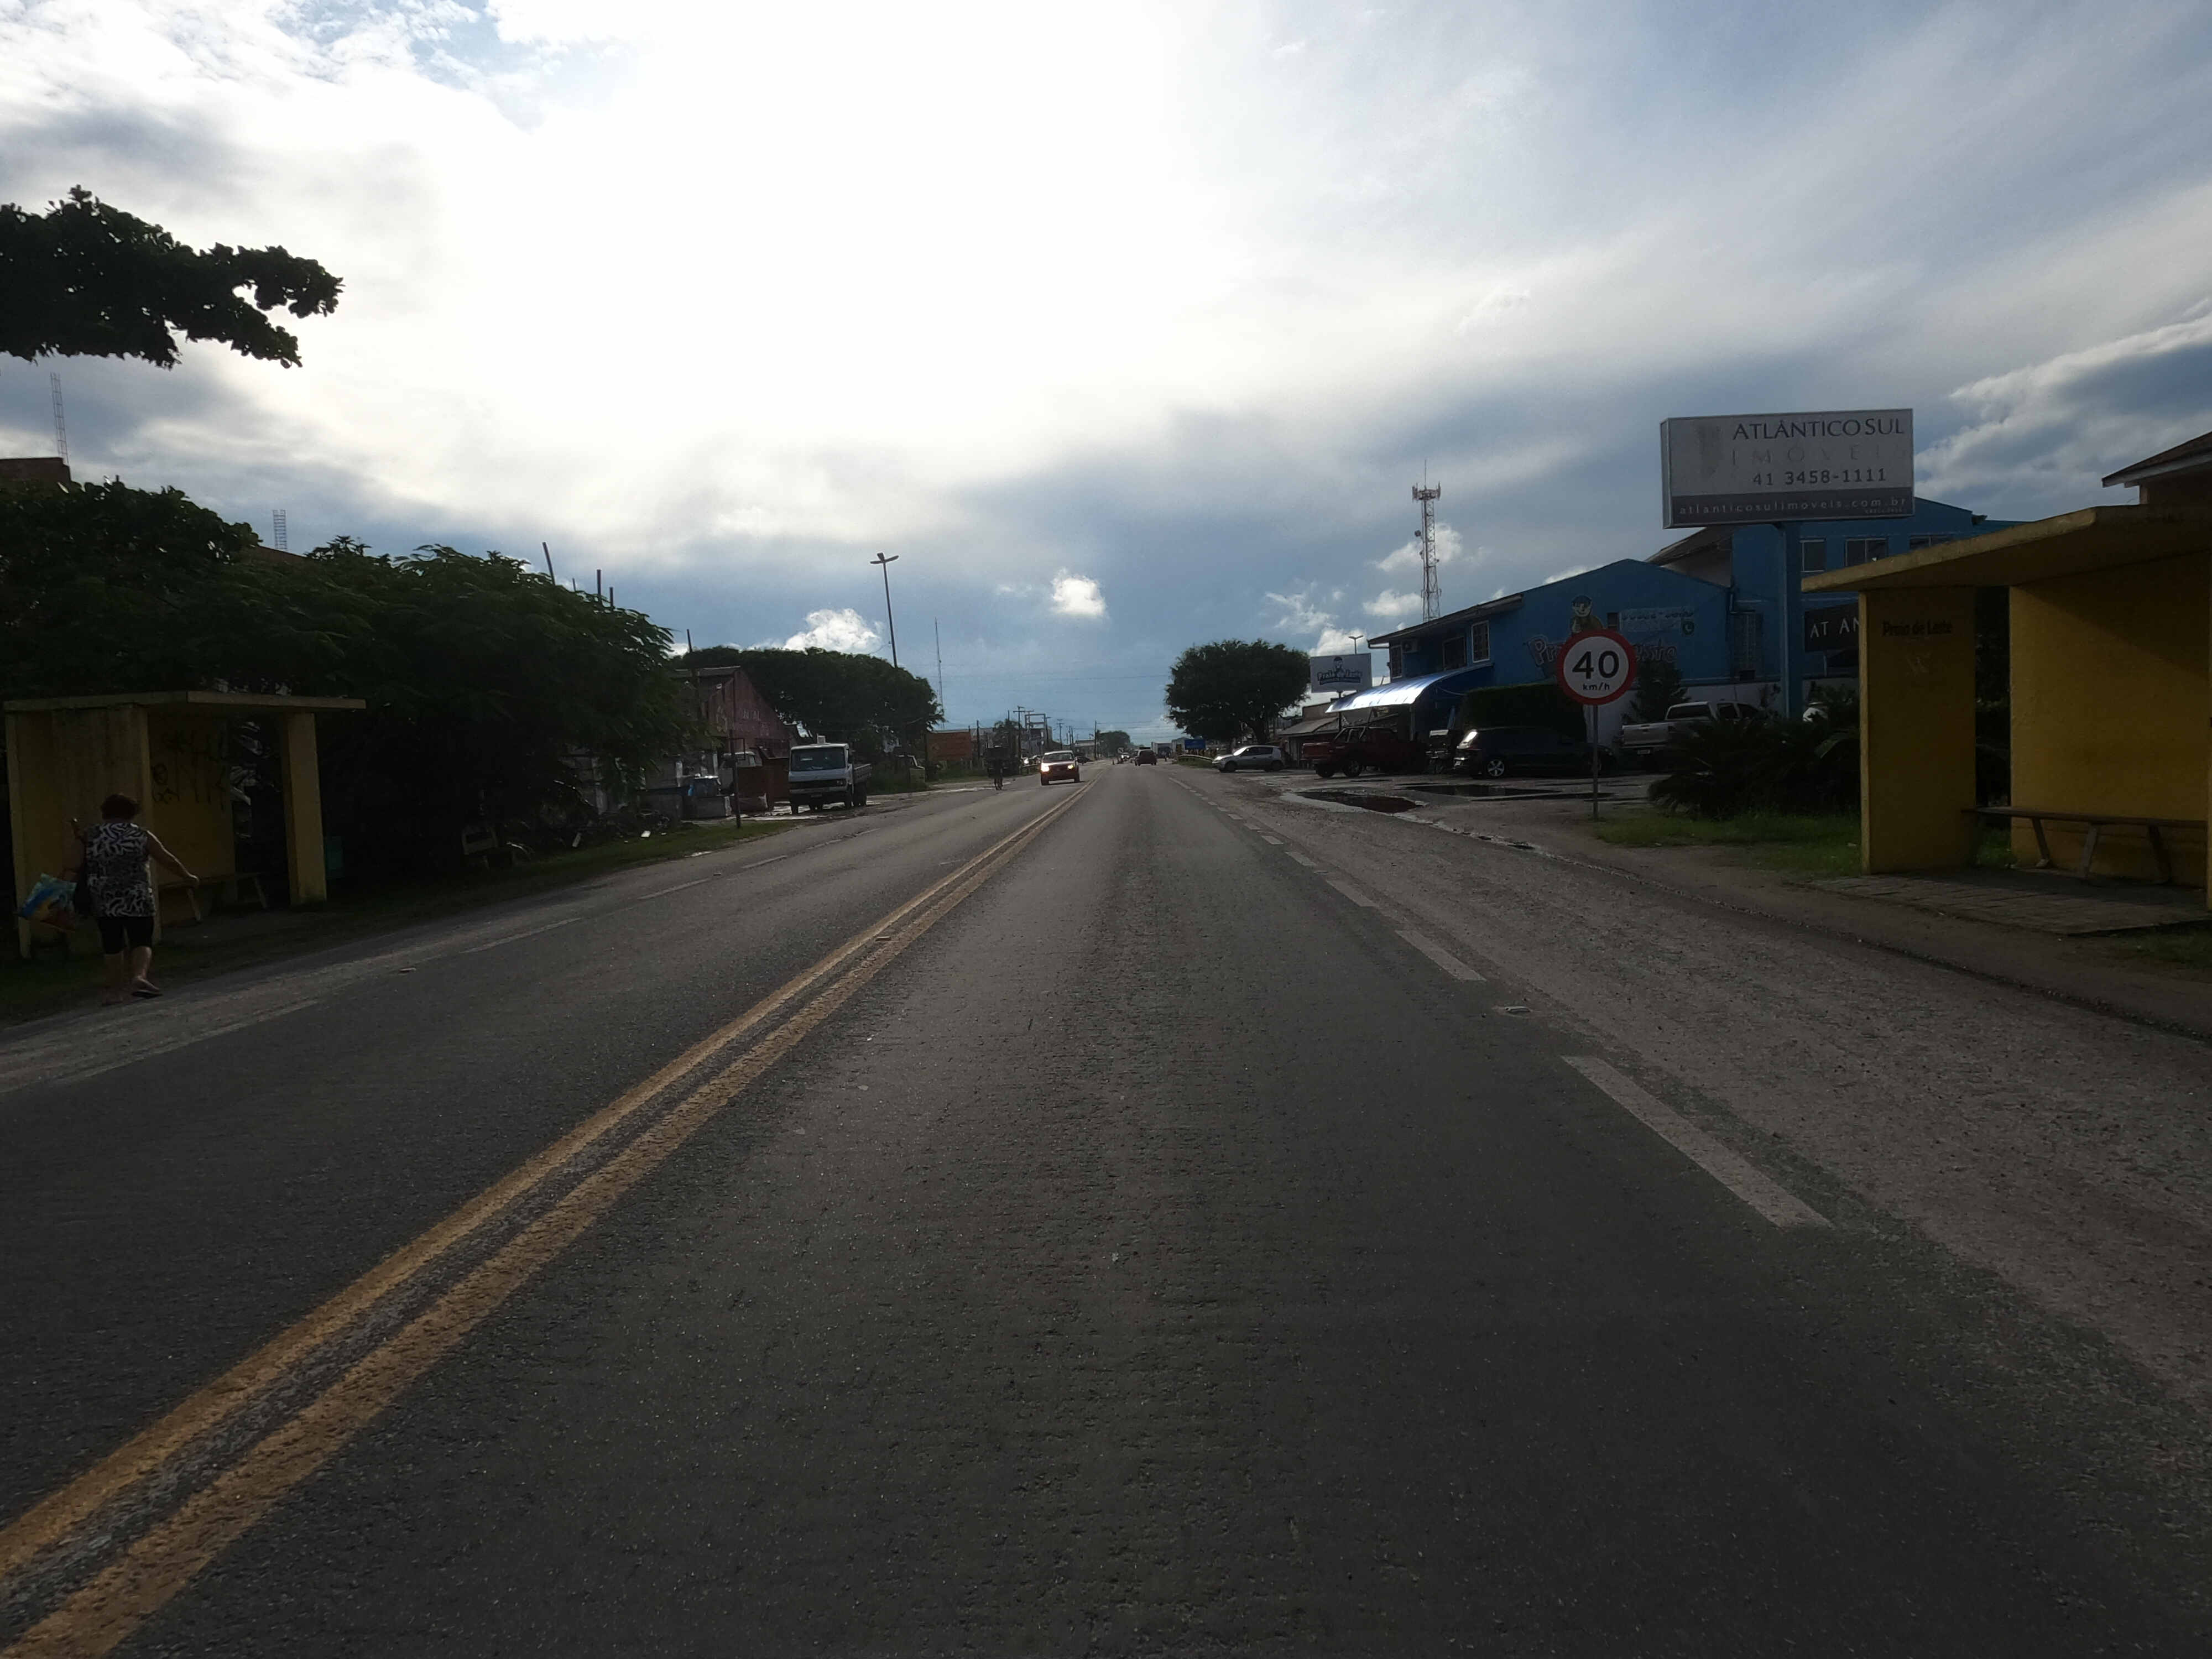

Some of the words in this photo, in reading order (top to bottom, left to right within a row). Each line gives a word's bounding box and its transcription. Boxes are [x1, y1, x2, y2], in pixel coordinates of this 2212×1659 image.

[1752, 473, 1774, 486] 41
[1785, 468, 1886, 486] 3458-1111
[1912, 619, 1925, 635] de
[1572, 650, 1619, 680] 40
[1583, 682, 1610, 691] km/h
